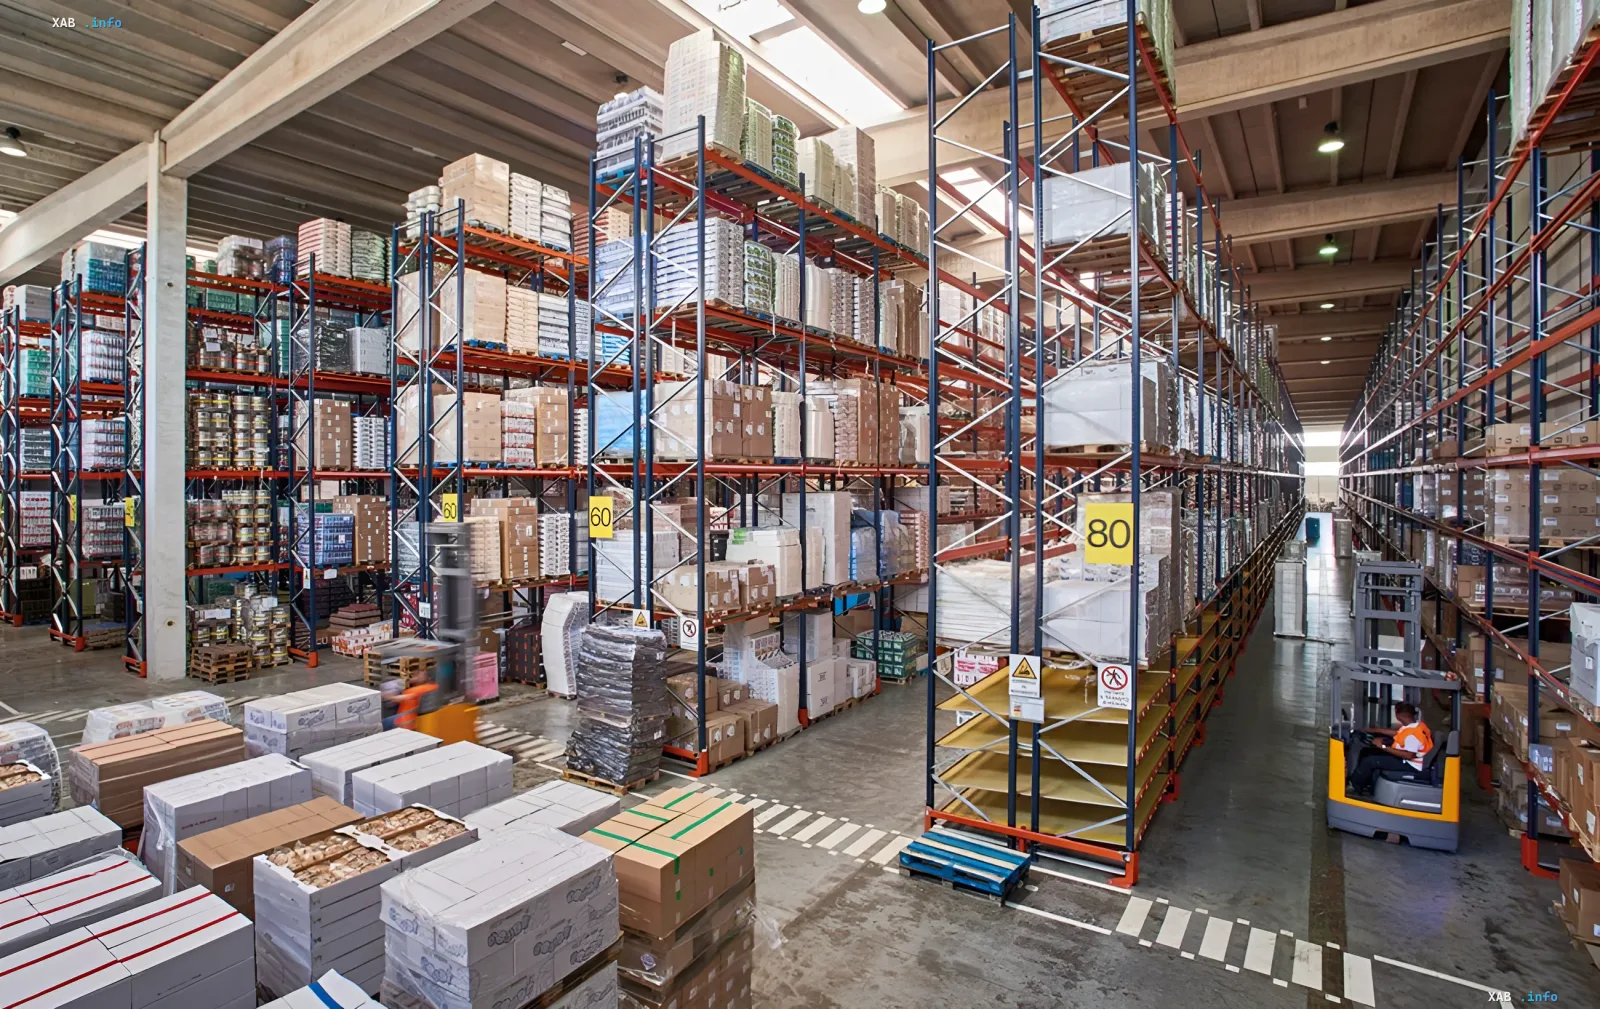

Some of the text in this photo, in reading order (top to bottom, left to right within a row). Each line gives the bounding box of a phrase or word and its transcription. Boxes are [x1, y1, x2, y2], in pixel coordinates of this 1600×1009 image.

[443, 502, 457, 519] 60
[590, 506, 611, 527] 60
[1087, 518, 1131, 549] 80
